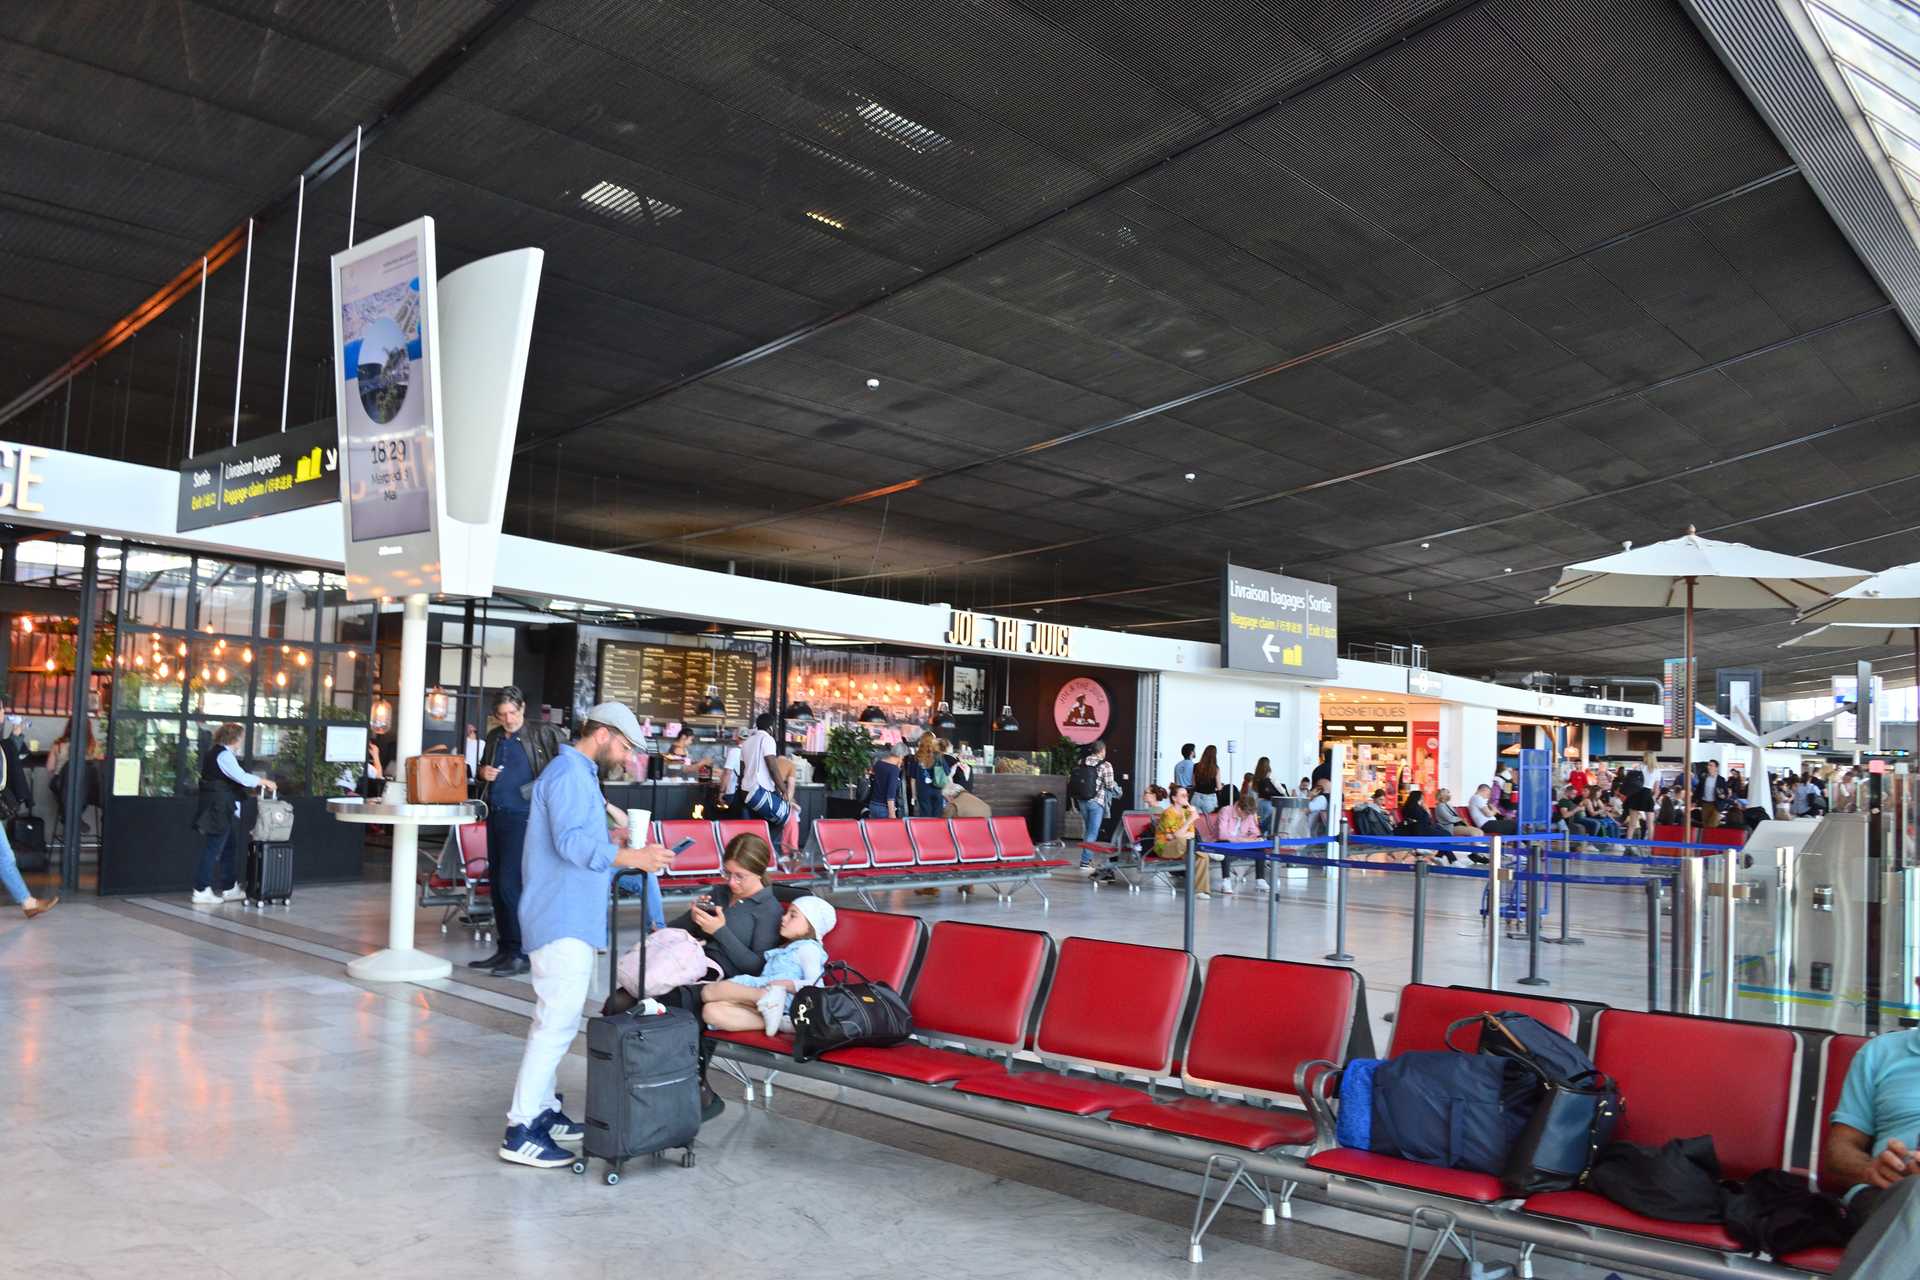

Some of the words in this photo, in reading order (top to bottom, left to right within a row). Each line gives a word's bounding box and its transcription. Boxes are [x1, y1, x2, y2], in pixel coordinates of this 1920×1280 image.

[225, 459, 252, 480] Livraison
[253, 453, 281, 475] bagages
[193, 469, 211, 488] Sortie
[1230, 579, 1270, 603] Livraison
[1271, 587, 1306, 612] bagages
[1309, 594, 1332, 613] Sortie
